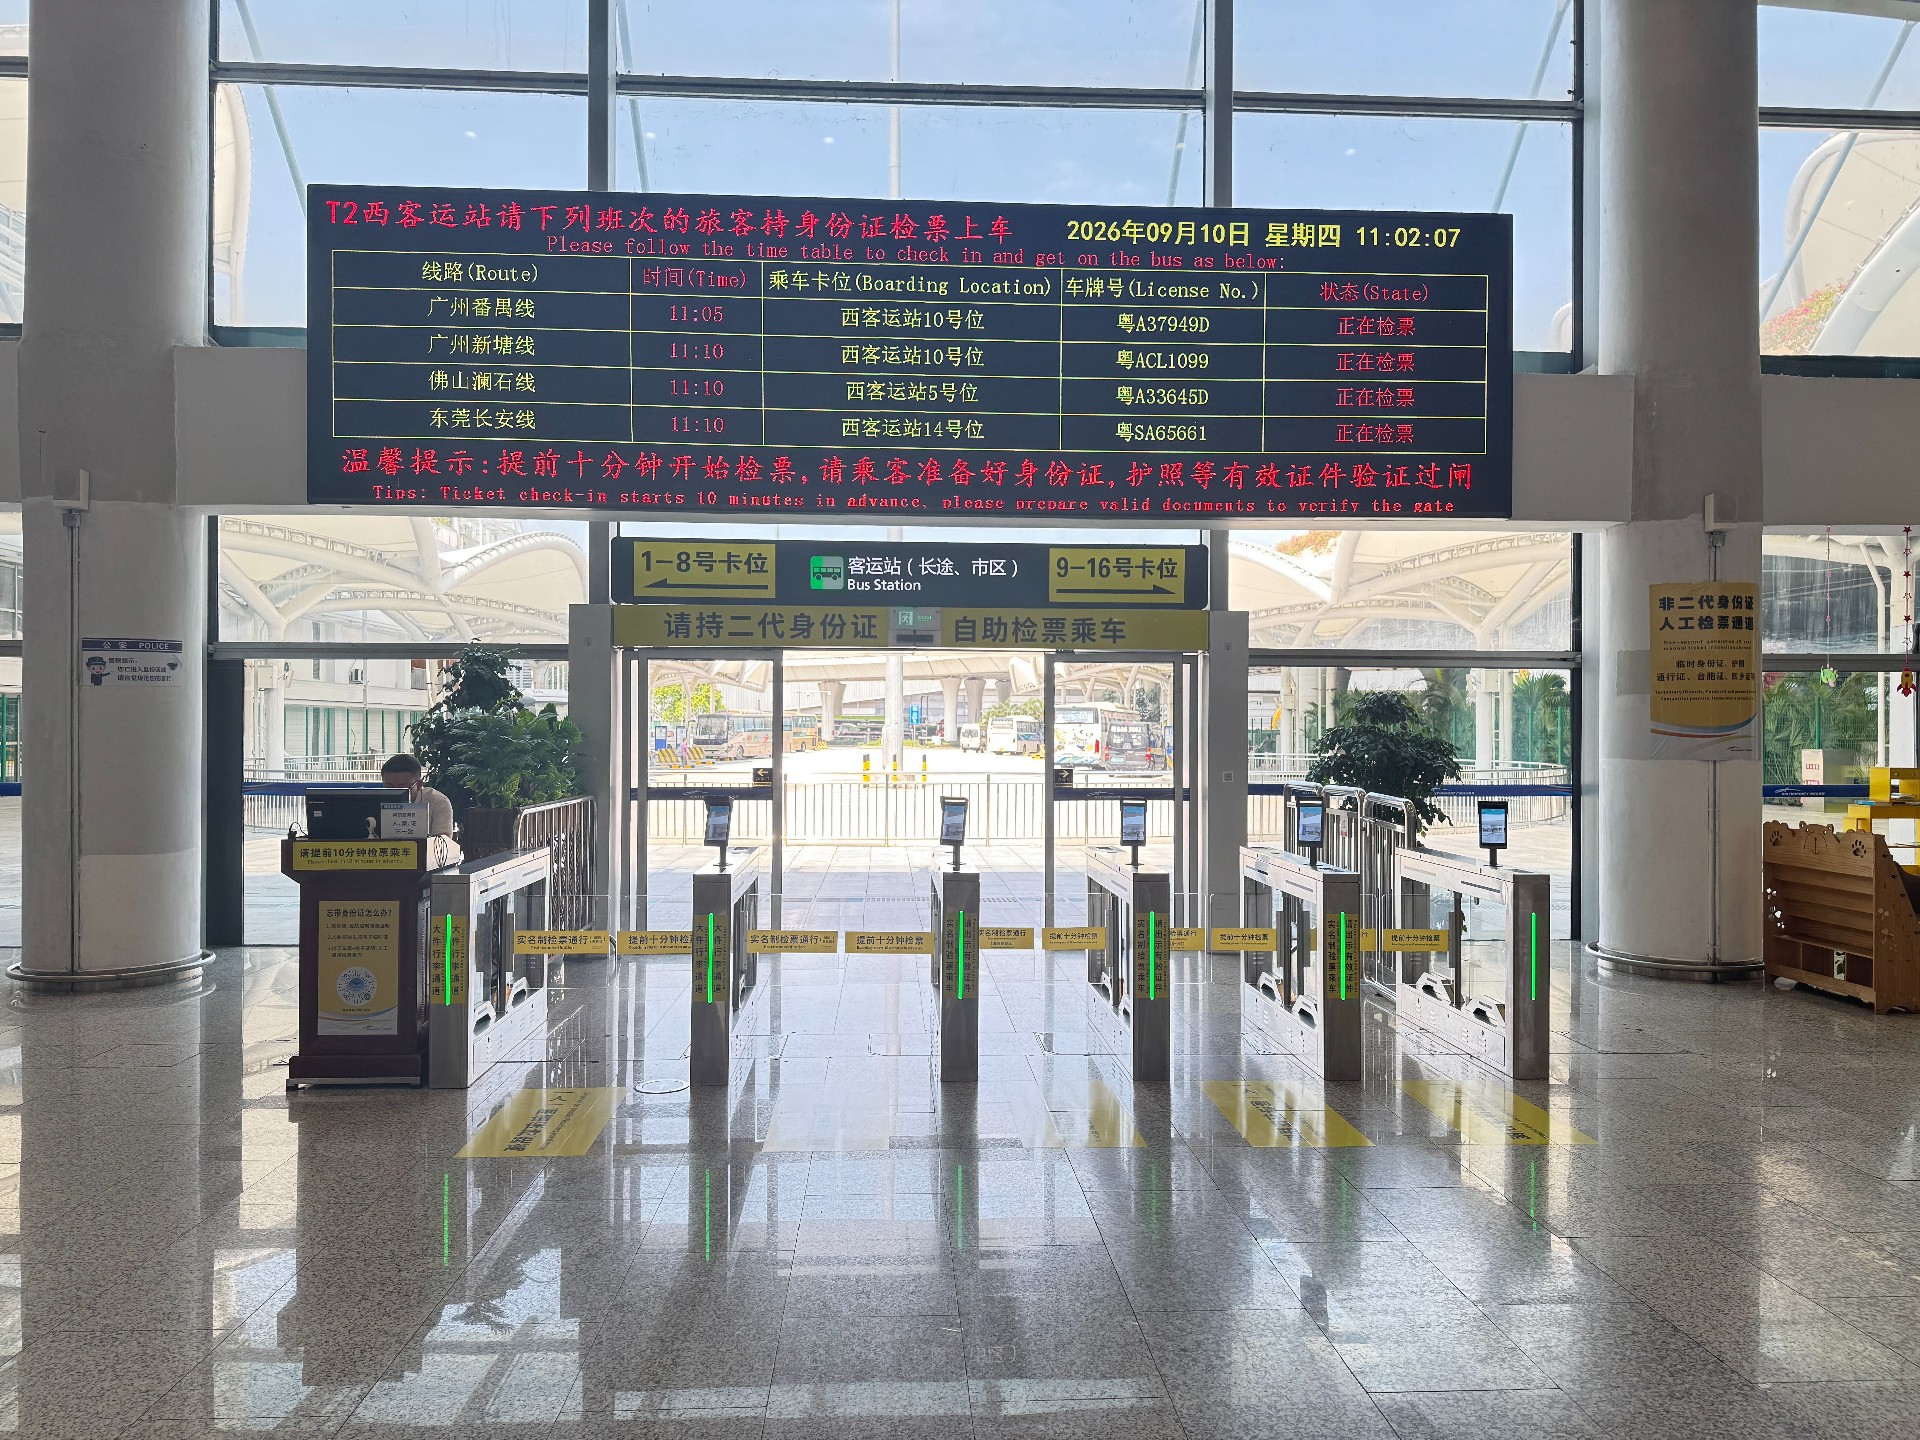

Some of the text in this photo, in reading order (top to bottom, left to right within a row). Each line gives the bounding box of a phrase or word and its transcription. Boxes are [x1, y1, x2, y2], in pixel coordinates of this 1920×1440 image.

[326, 200, 1013, 244] T2西客运站请下列班次的旅客持身份证检票上车
[1067, 219, 1461, 248] 2026年09月10日 星期四 11:02:07
[546, 235, 1286, 270] Please follow the time table to check in and get on the bus as below:
[421, 260, 539, 283] 线路(Route)
[643, 266, 748, 288] 时间(Time)
[768, 270, 1052, 297] 乘车卡位(Boarding Location)
[1065, 277, 1259, 302] 车牌号(License No.)
[1319, 281, 1430, 303] 状态(State)
[428, 296, 535, 318] 广州番禺线
[670, 305, 724, 322] 11:05
[841, 307, 985, 330] 西客运站10号位
[1116, 313, 1210, 334] 粤A37949D
[1336, 316, 1416, 336] 正在检票
[428, 333, 535, 356] 广州新塘线
[670, 343, 724, 359] 11:10
[841, 344, 985, 367] 西客运站10号位
[1116, 349, 1209, 370] 粤ACL1099
[1335, 352, 1415, 372] 正在检票
[428, 370, 536, 392] 佛山澜石线
[670, 379, 725, 396] 11:10
[846, 381, 979, 403] 西客运站5号位
[1115, 385, 1209, 406] 粤A33645D
[1335, 388, 1415, 408] 正在检票
[429, 407, 536, 430] 东莞长安线
[671, 416, 725, 433] 11:10
[841, 418, 985, 439] 西客运站14号位
[1115, 422, 1207, 442] 粤SA65661
[1334, 424, 1414, 444] 正在检票
[373, 485, 428, 500] Tips:
[440, 486, 506, 501] Ticket
[519, 488, 607, 503] check-in
[620, 490, 685, 505] starts
[698, 491, 717, 505] 10
[729, 493, 804, 507] minutes
[817, 493, 836, 507] in
[943, 496, 1005, 509] please
[1017, 497, 1089, 511] prepare
[1100, 497, 1151, 511] valid
[1162, 498, 1255, 512] documents
[1267, 499, 1288, 512] to
[1298, 499, 1360, 513] verify
[1372, 499, 1402, 512] the
[1413, 501, 1455, 513] gate
[847, 579, 922, 591] Bus Station
[1658, 595, 1754, 611] 非二代身份证
[663, 611, 878, 640] 请持二代身份证
[954, 615, 1127, 644] 自助检票乘车
[1659, 616, 1754, 631] 人工检票通道
[138, 642, 169, 650] POLICE
[300, 848, 411, 858] 请提前10分钟检票乘车
[326, 908, 392, 918] 忘带身份证怎么办?
[517, 935, 589, 945] 实名制检票通行
[628, 935, 693, 945] 提前十分钟检
[750, 934, 819, 944] 实名制检票通行
[856, 936, 924, 945] 提前十分钟检票
[1219, 933, 1269, 941] 提前十分钟检票
[1391, 934, 1440, 942] 提前十分钟检票
[432, 924, 441, 995] 大件行李通道
[451, 924, 460, 995] 大件行李通道
[695, 923, 704, 994] 大件行李通道
[713, 924, 722, 993] 大件行李通道
